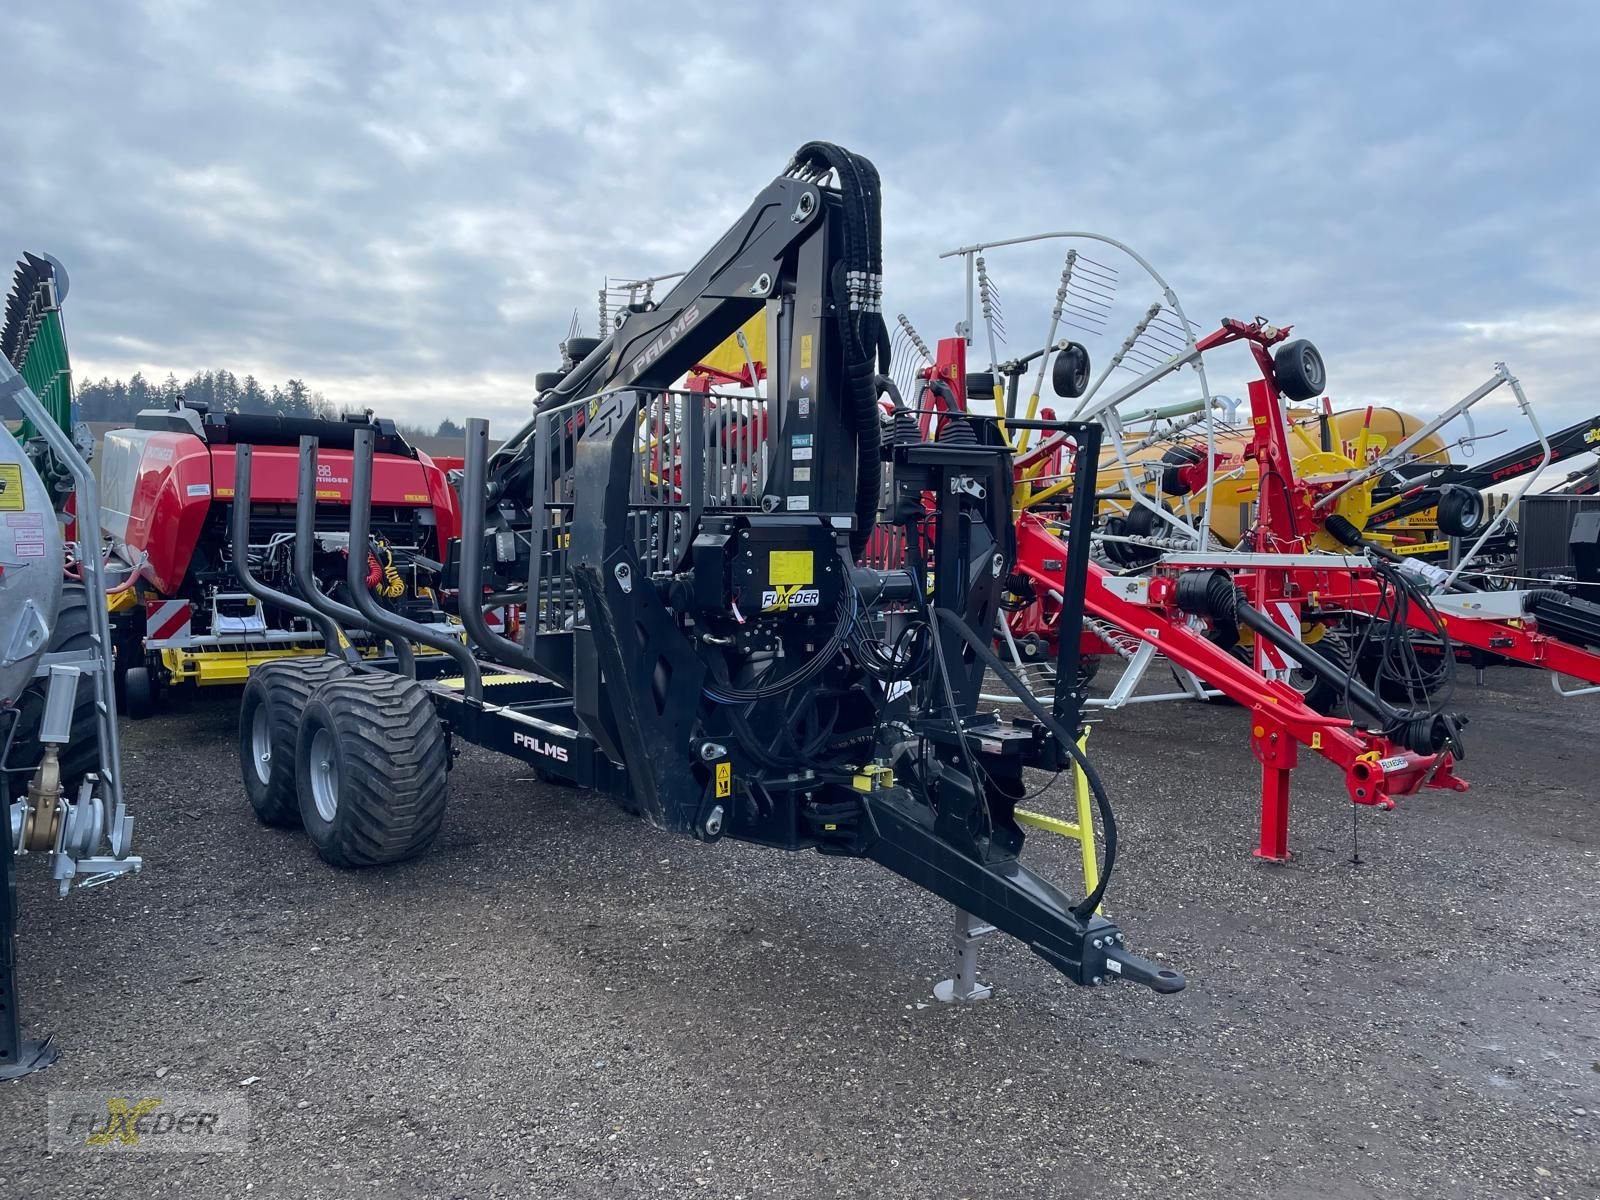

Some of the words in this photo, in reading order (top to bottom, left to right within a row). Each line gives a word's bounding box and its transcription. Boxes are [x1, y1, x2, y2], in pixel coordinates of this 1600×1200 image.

[631, 303, 700, 376] PALMS
[316, 476, 349, 484] TTINGER
[513, 731, 569, 763] PALMS
